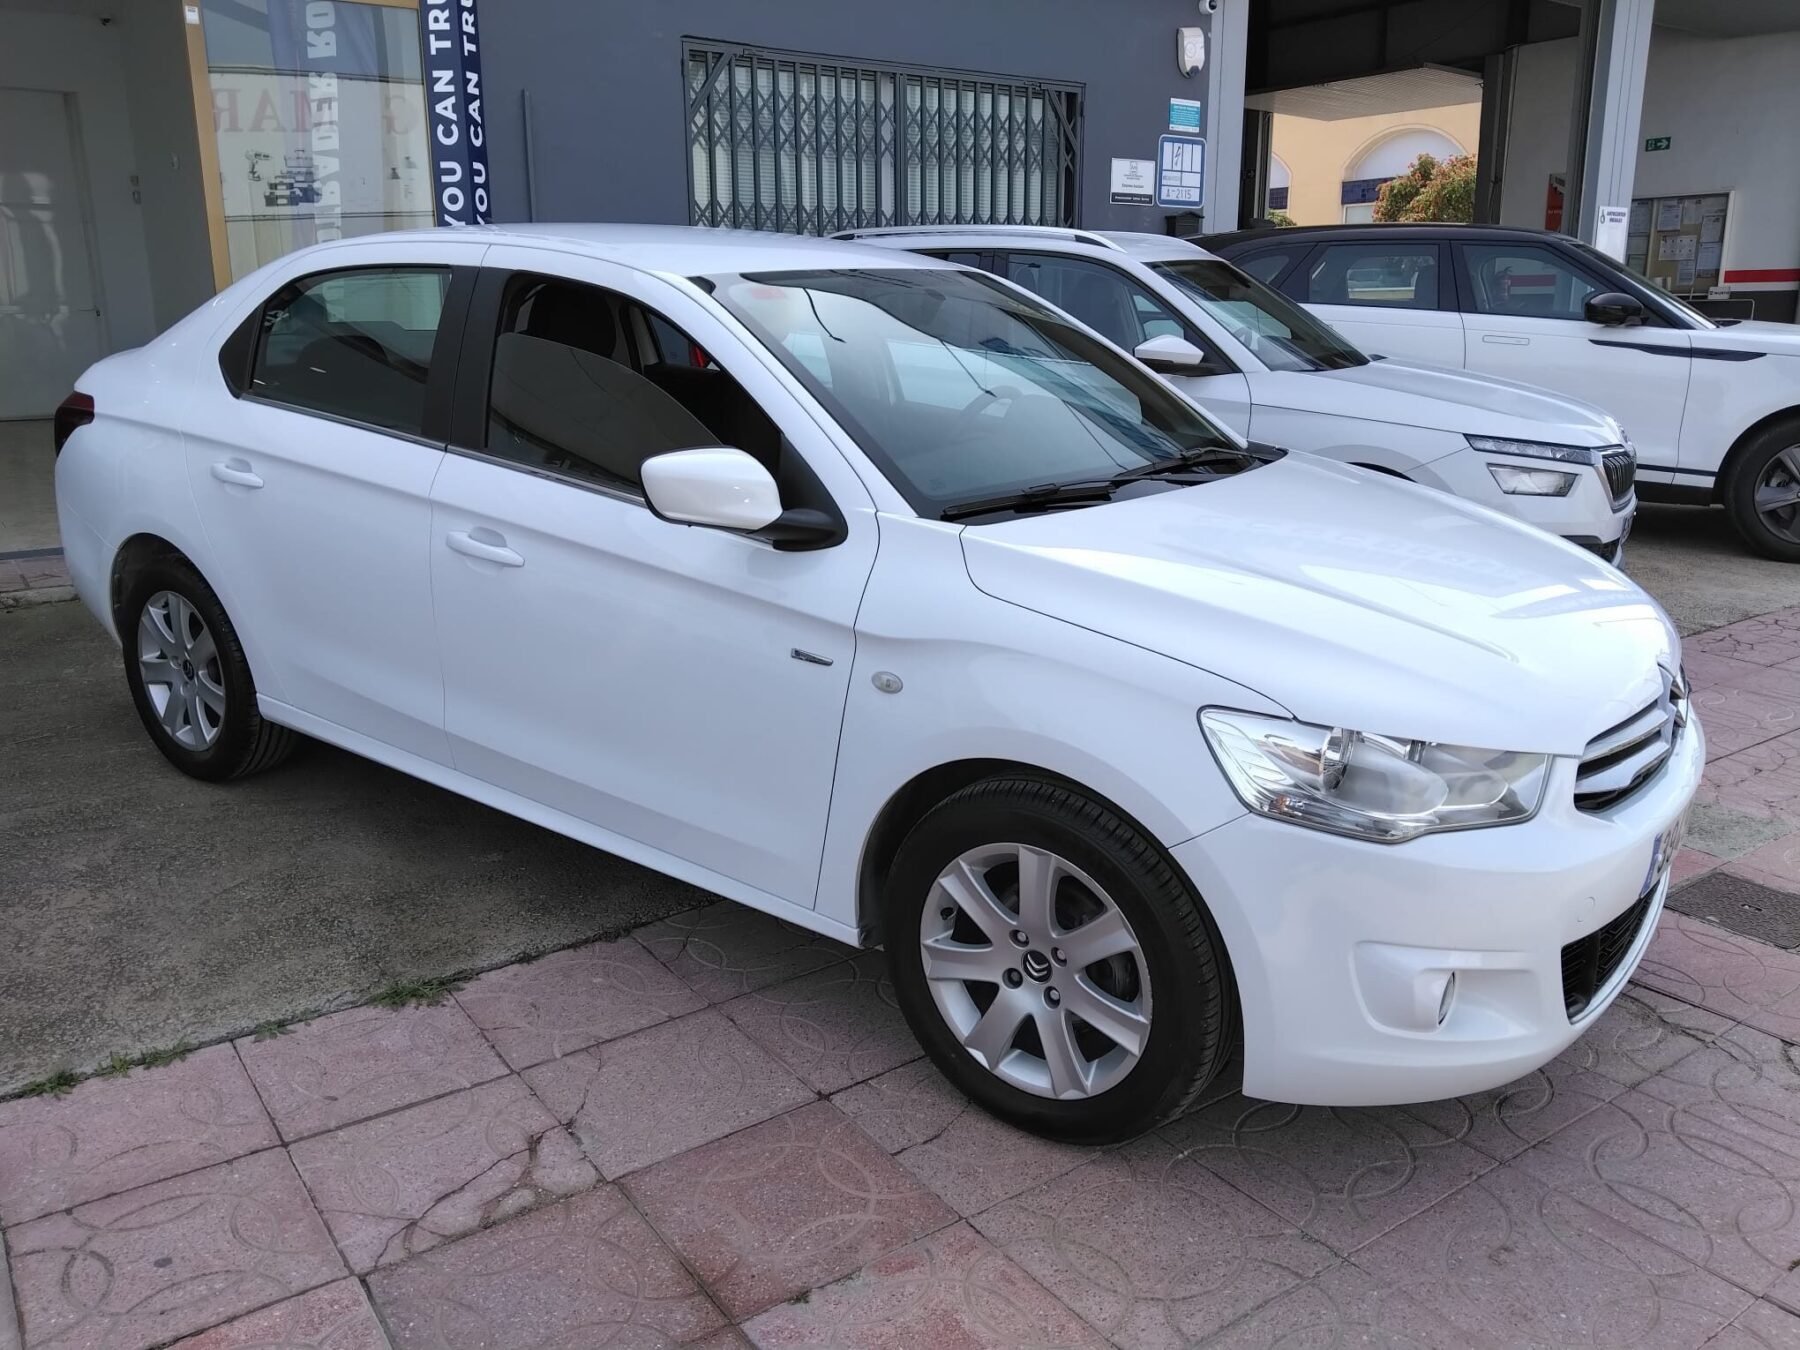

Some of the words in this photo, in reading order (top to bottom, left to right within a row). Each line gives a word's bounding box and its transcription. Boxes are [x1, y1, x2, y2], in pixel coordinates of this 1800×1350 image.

[427, 0, 452, 56] TR
[432, 70, 459, 146] CAN
[466, 71, 483, 147] CAN
